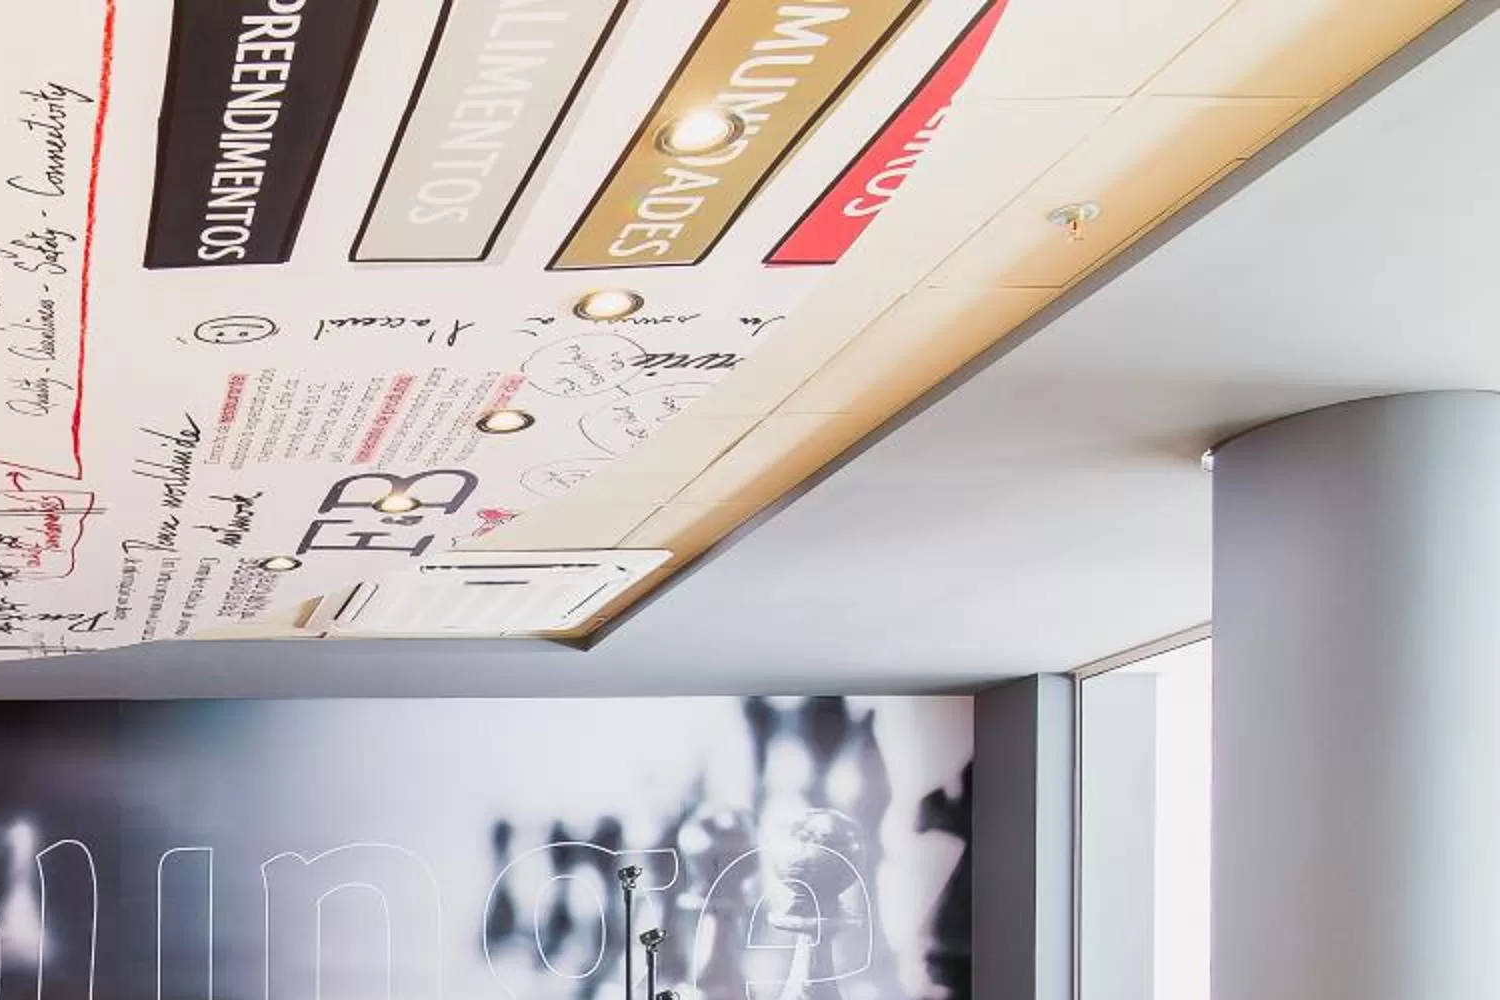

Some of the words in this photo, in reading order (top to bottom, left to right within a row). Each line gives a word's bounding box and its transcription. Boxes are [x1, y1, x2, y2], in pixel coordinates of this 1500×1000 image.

[6, 81, 95, 197] Connectivity
[408, 0, 570, 225] LIMENTOS
[131, 412, 201, 509] worldwide
